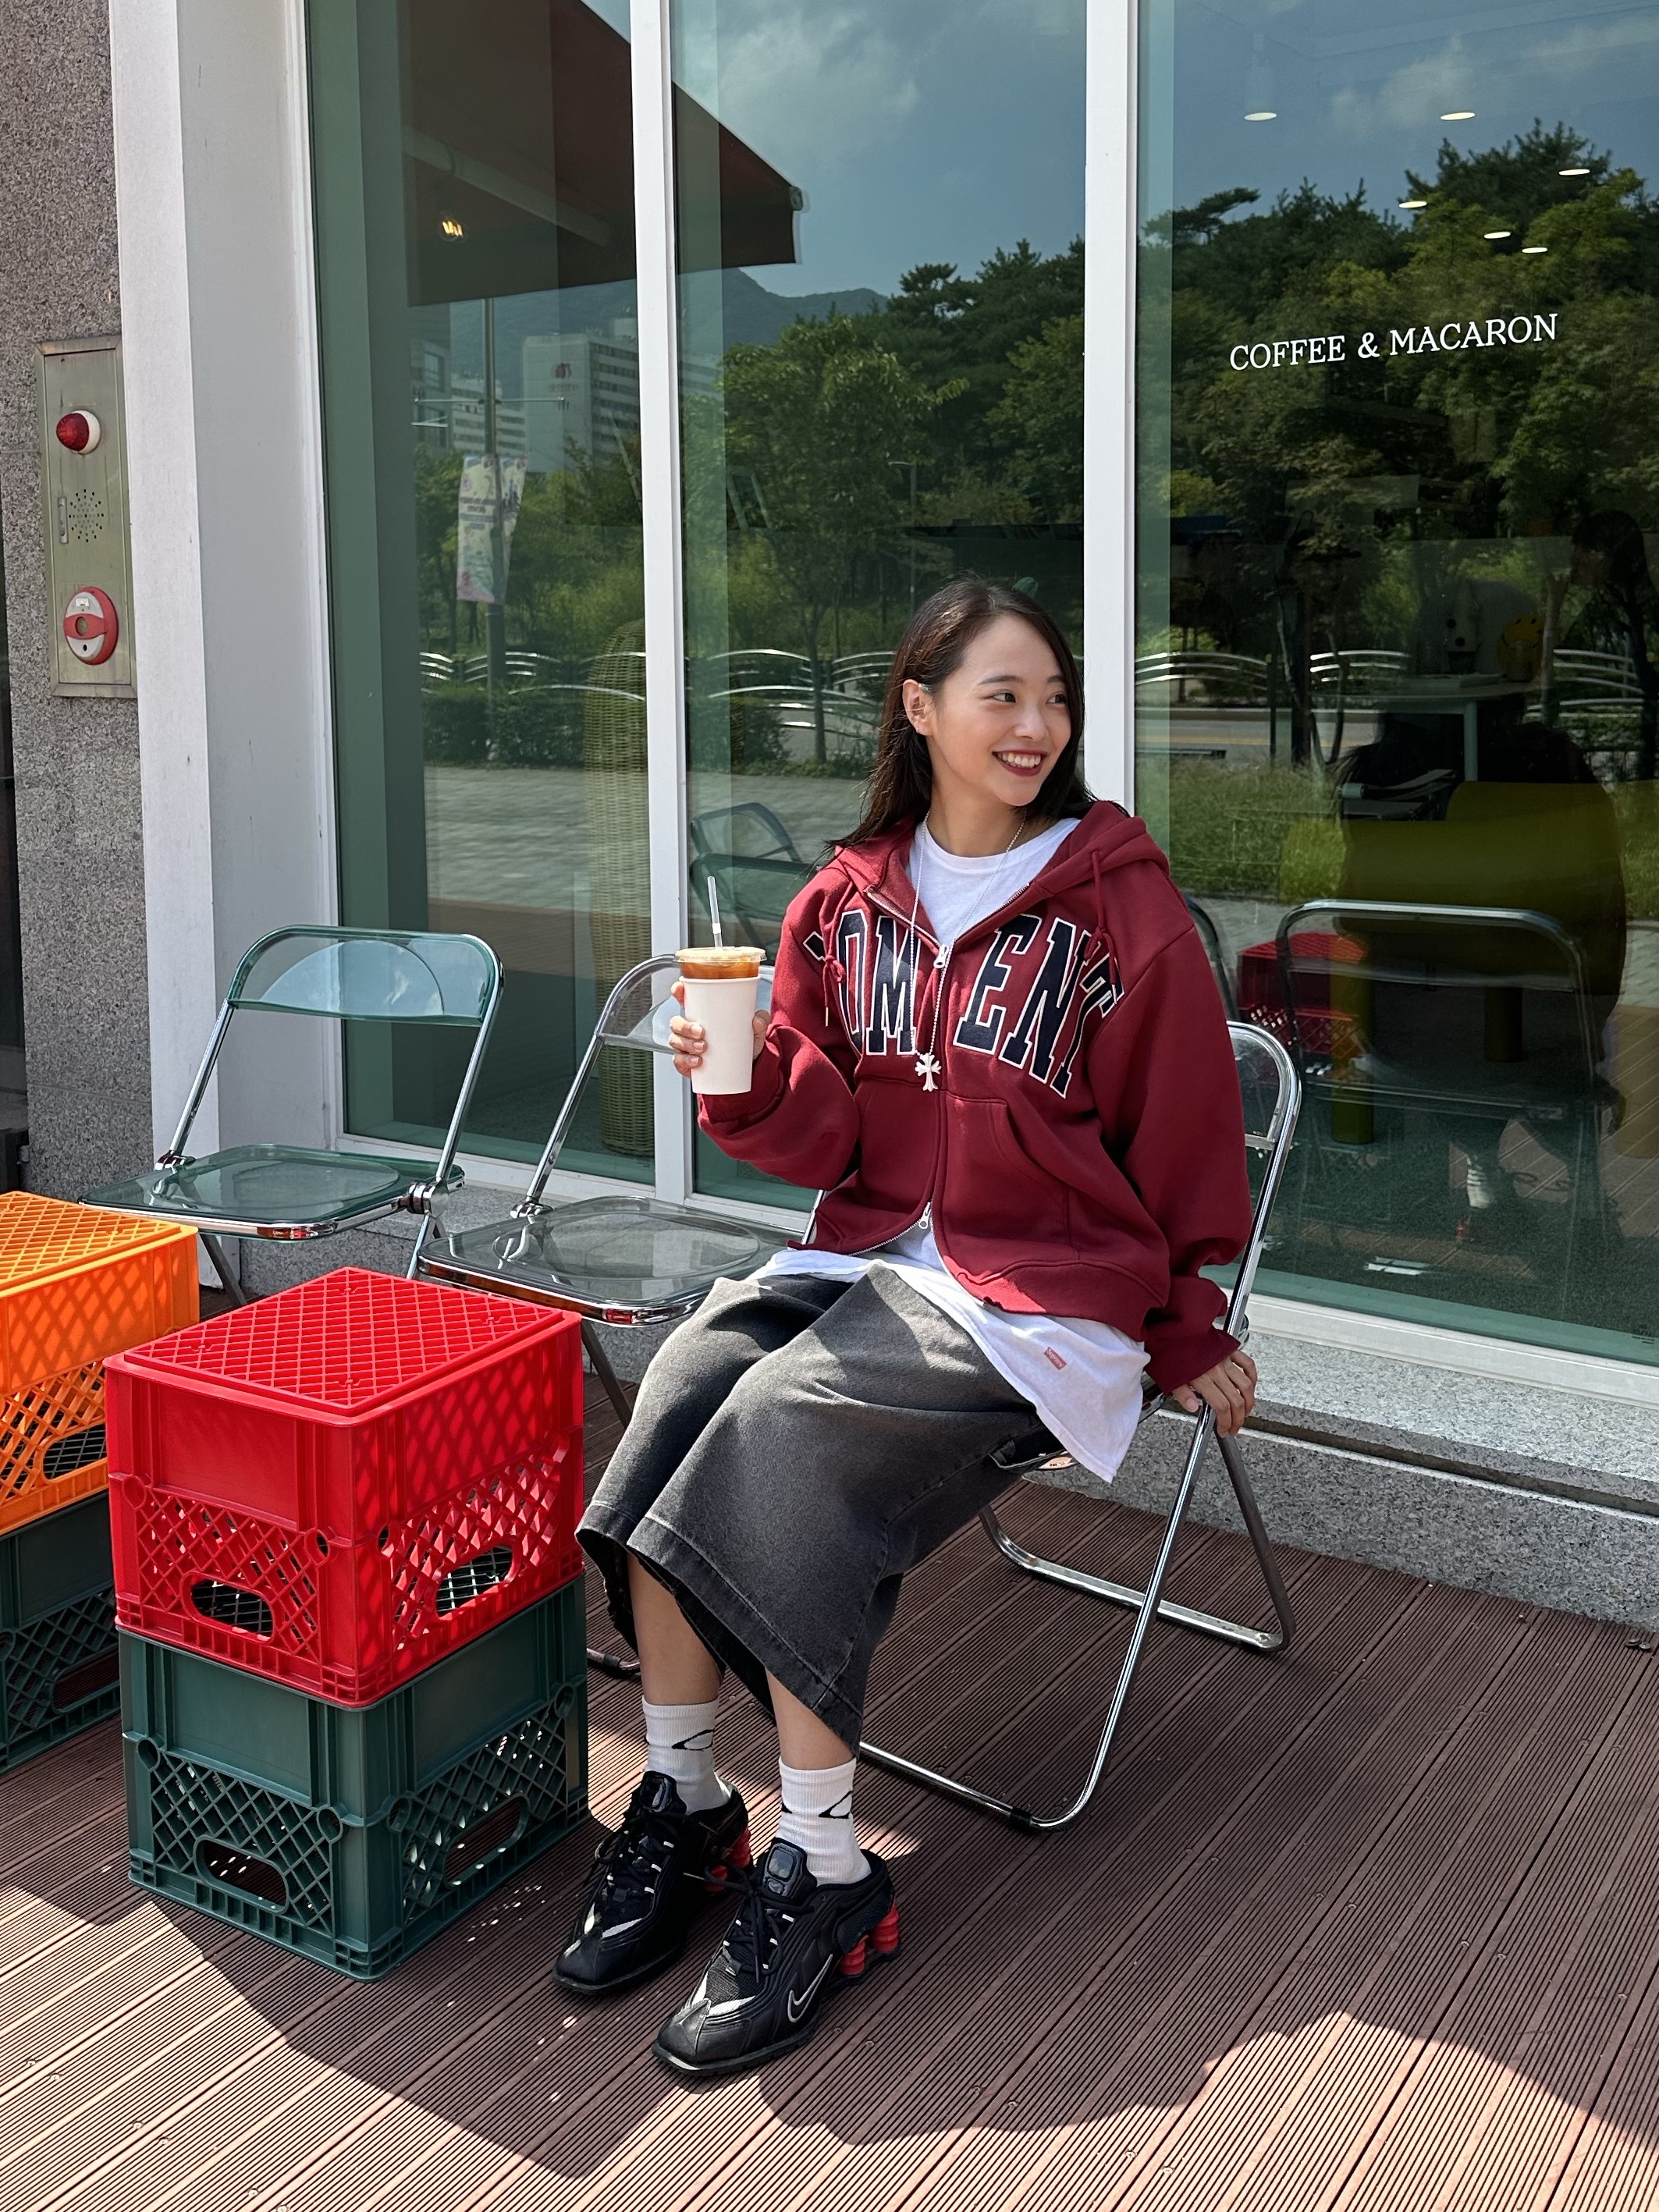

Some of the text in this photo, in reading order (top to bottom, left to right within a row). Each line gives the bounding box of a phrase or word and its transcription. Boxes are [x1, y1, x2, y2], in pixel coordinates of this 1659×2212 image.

[1231, 314, 1558, 371] COFFEE & MACARON
[803, 908, 1124, 1099] OMENT
